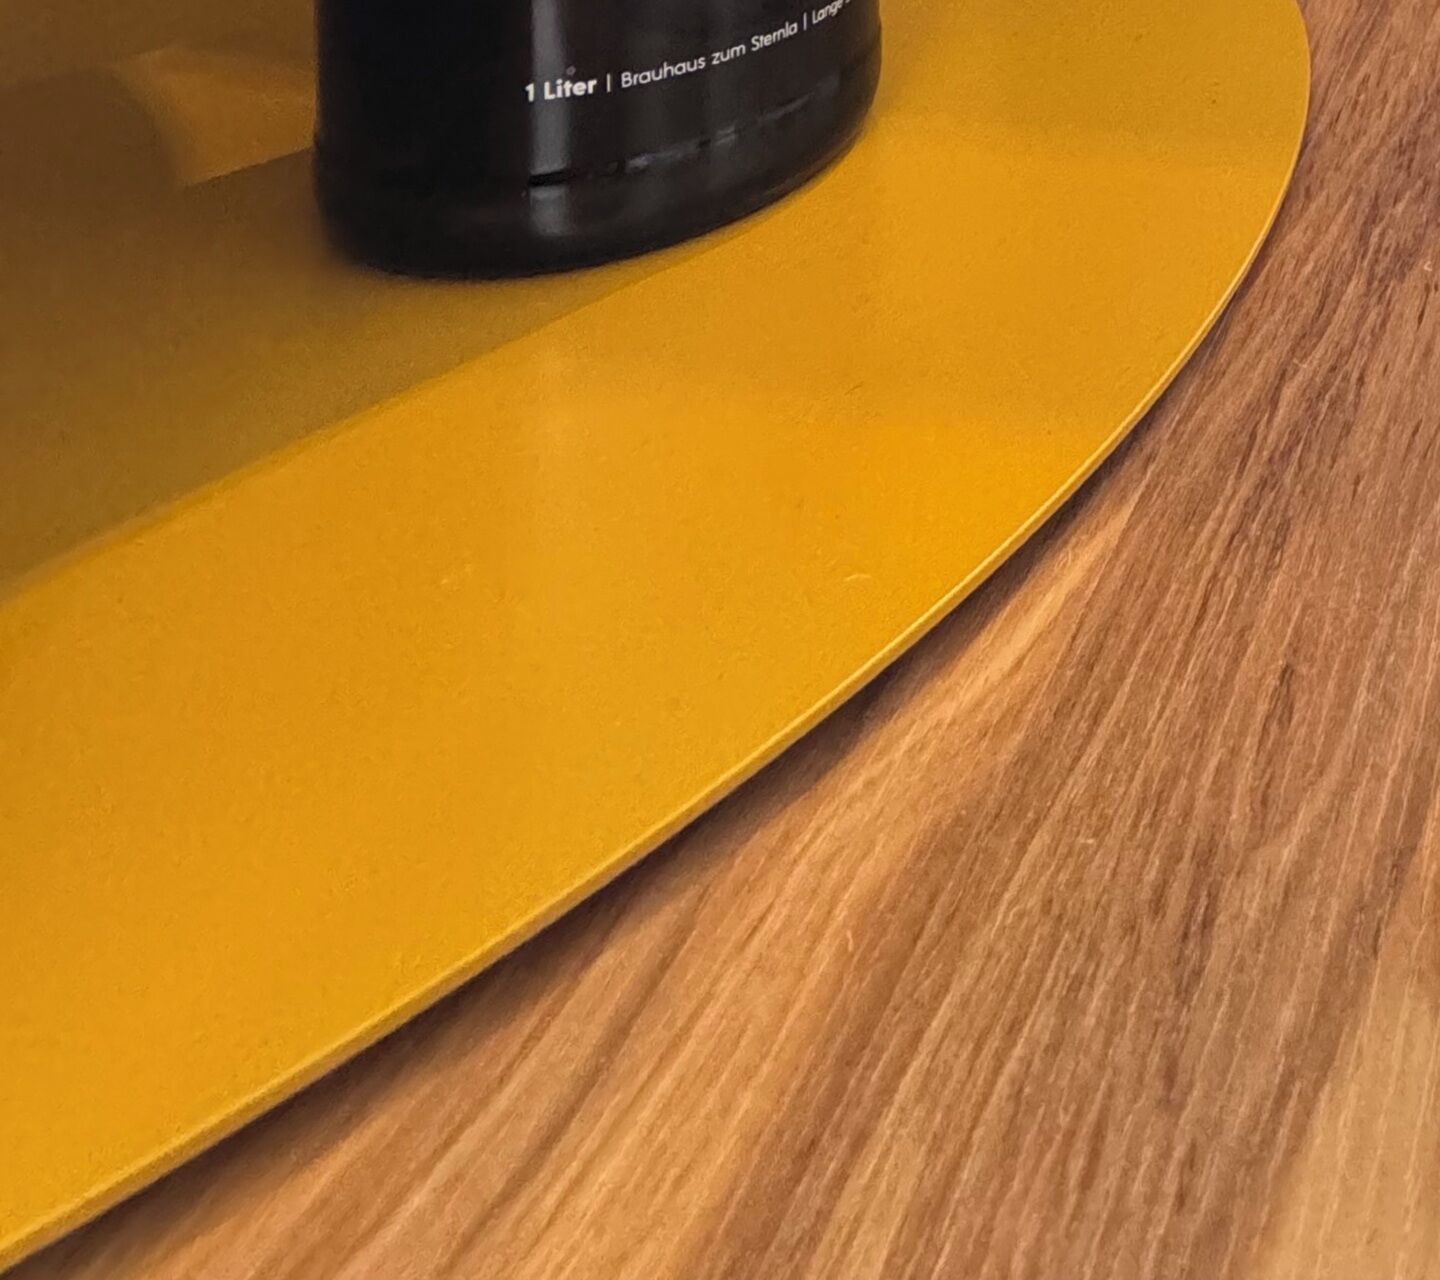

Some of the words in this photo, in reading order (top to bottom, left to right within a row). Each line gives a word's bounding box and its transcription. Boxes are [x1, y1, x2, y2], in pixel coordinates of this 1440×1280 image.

[525, 82, 536, 103] 1
[543, 76, 598, 101] Liter
[620, 55, 707, 89] Brauhaus
[711, 42, 747, 65] zum
[750, 20, 799, 53] Sternla
